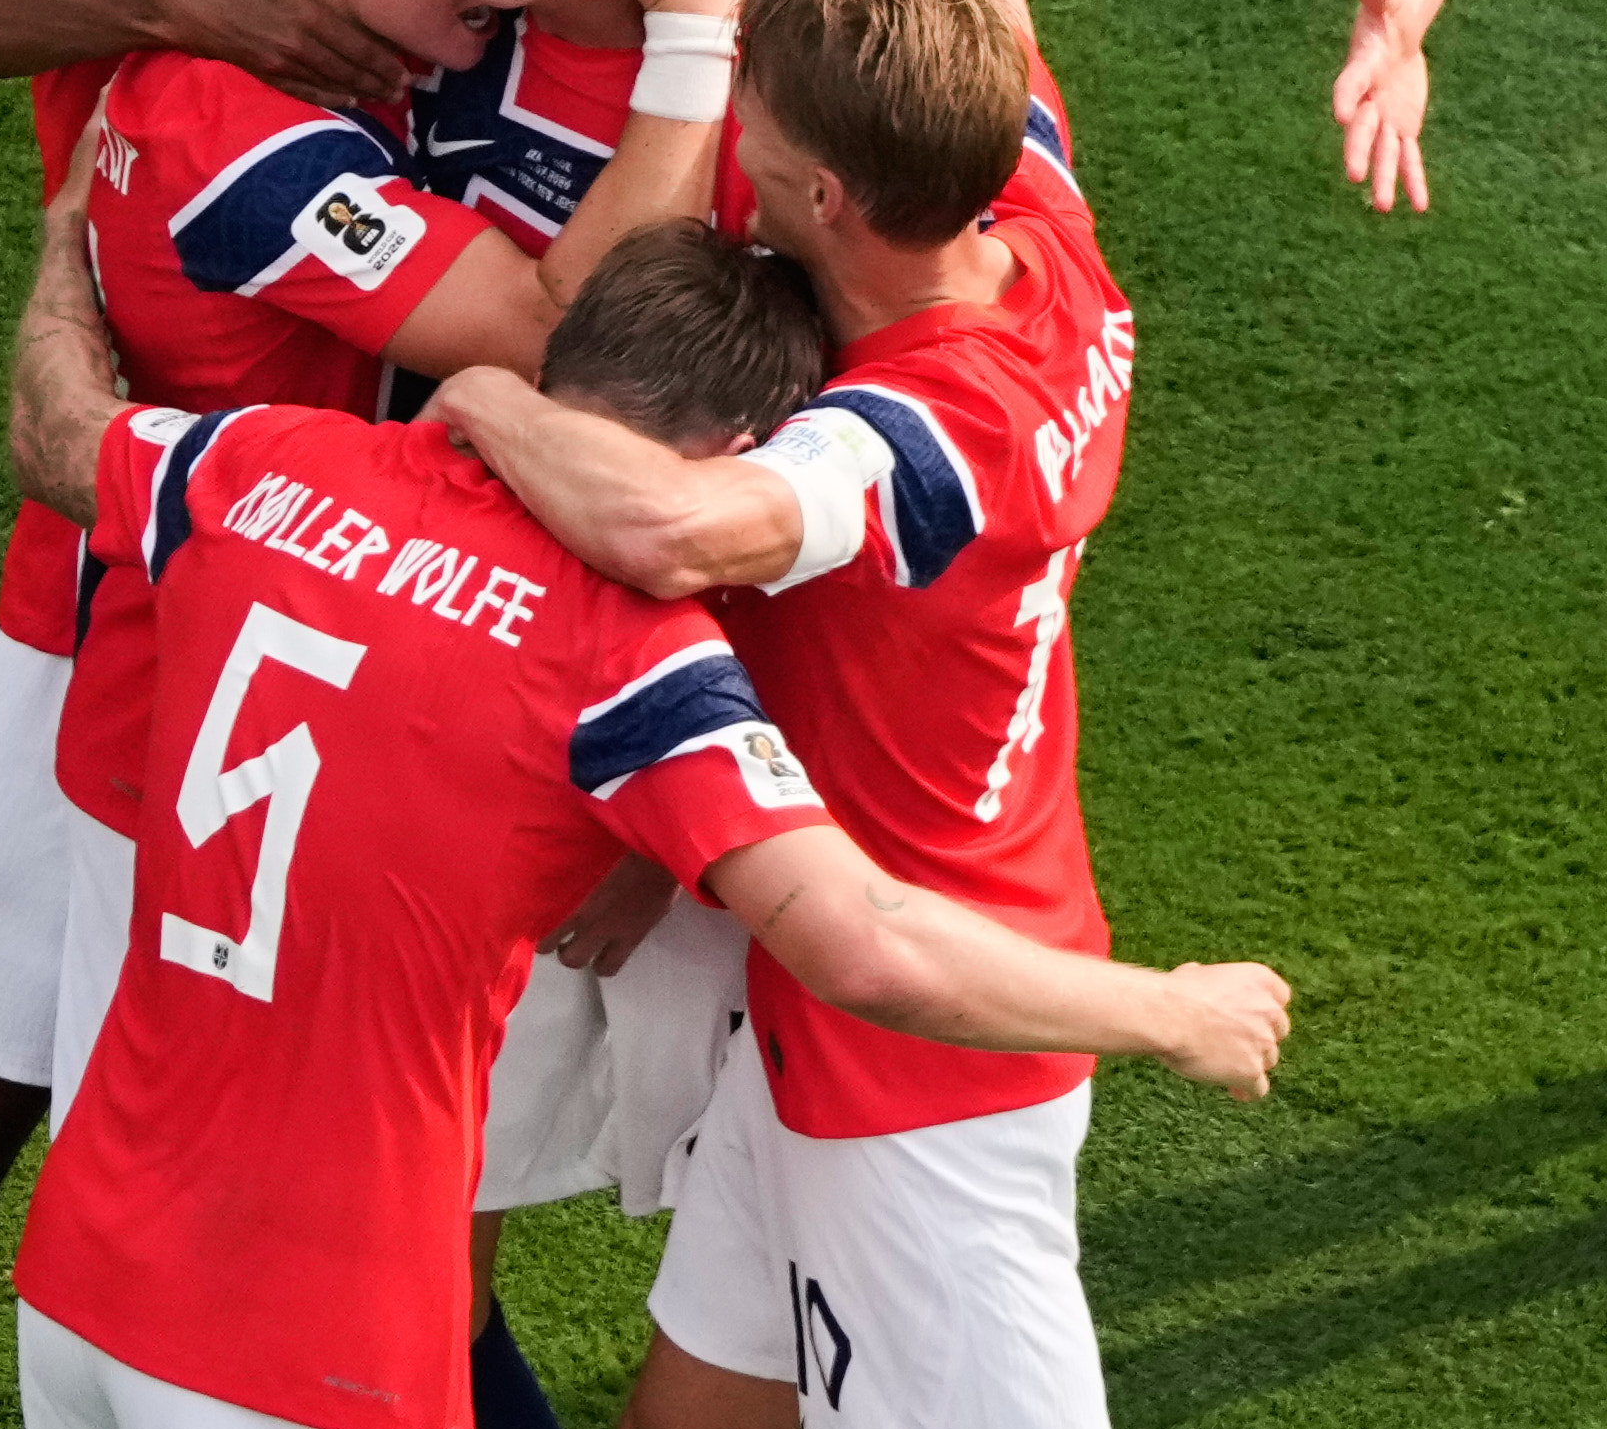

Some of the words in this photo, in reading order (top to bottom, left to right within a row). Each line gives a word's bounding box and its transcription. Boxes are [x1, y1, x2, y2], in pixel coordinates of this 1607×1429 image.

[360, 228, 381, 248] FIFA
[367, 241, 388, 265] WORLD
[373, 235, 407, 271] 2026
[376, 538, 548, 648] WOLFE
[160, 601, 369, 1003] 5
[789, 1258, 853, 1412] 10
